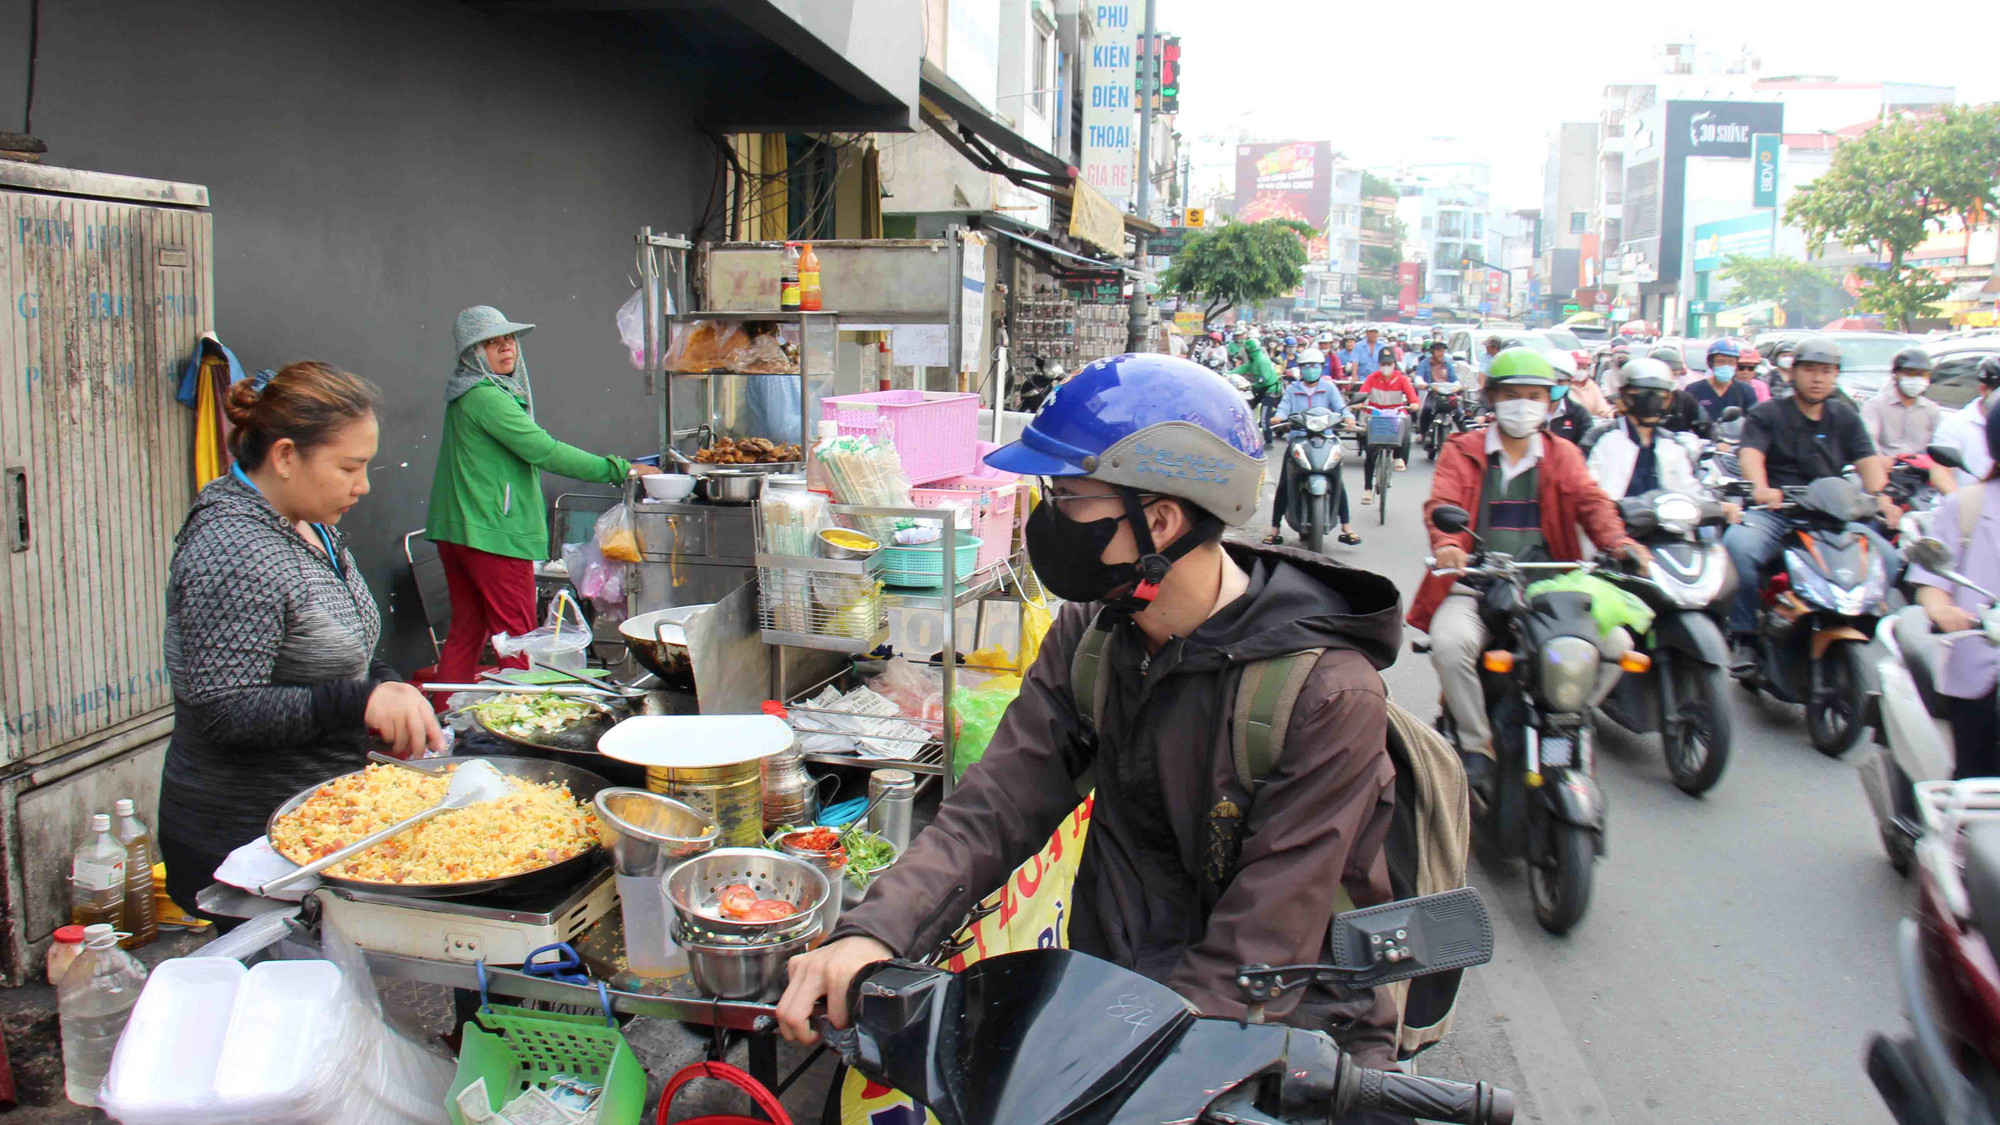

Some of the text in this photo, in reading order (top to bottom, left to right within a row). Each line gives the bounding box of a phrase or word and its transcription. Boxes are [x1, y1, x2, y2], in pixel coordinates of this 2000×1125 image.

[1097, 5, 1128, 32] PHỤ
[1093, 41, 1130, 73] KIỆN
[1092, 81, 1129, 113] ĐIỆN
[1089, 125, 1130, 153] THOẠI
[1761, 162, 1774, 193] BIDV
